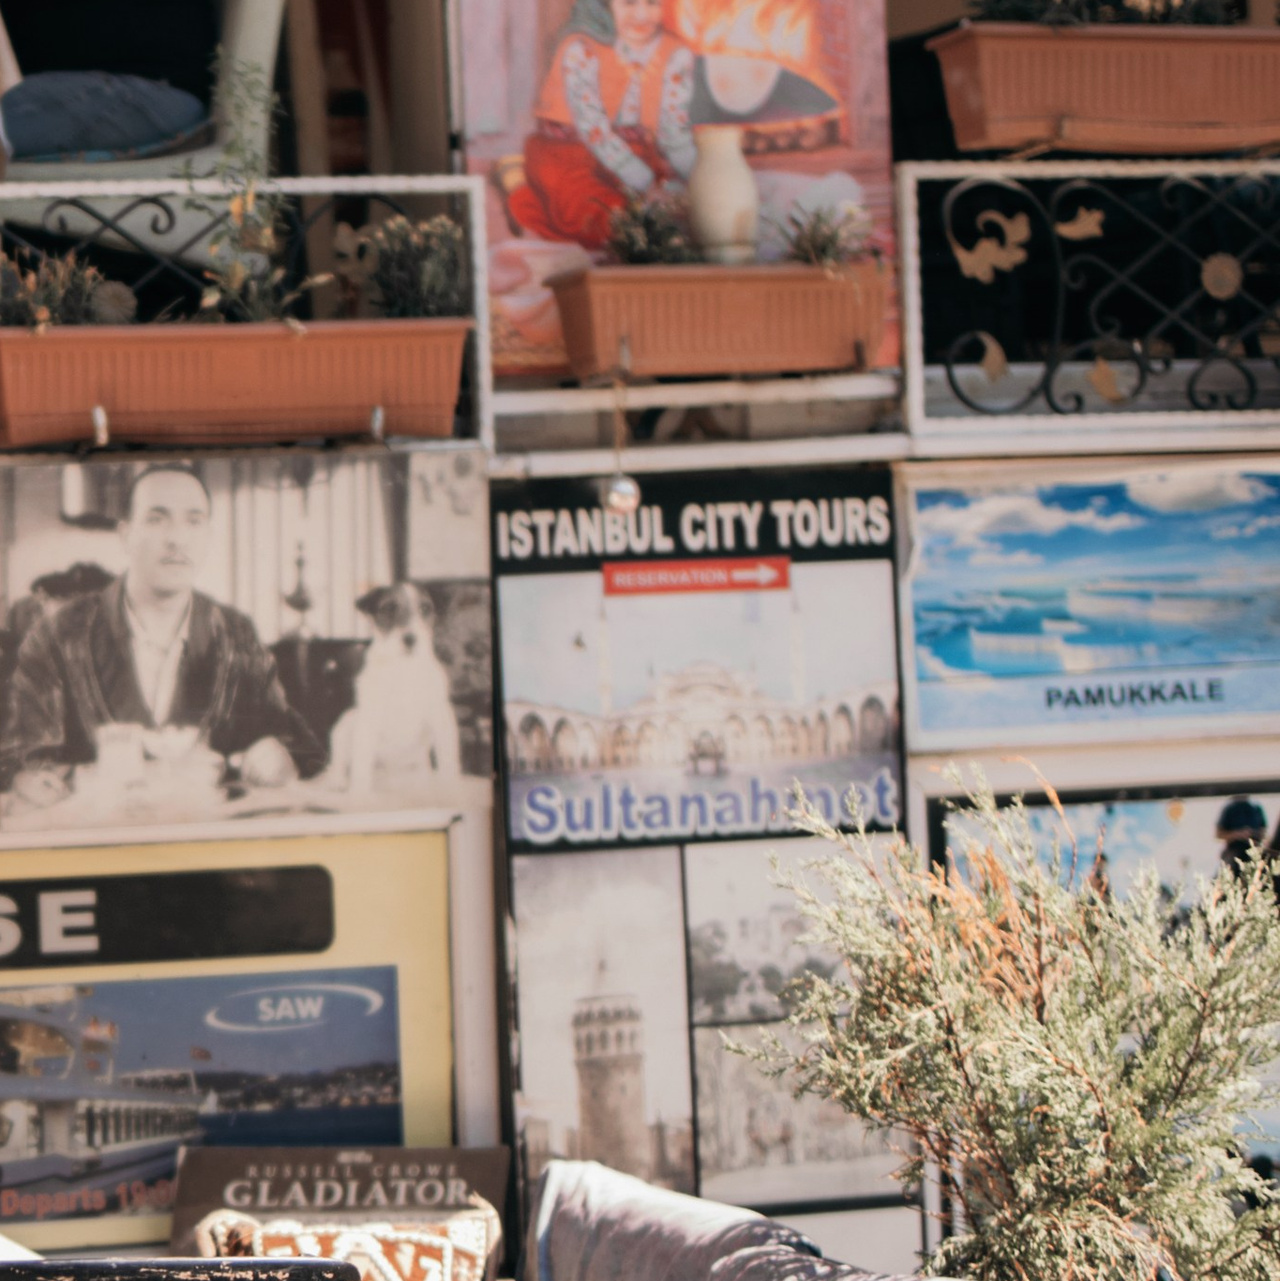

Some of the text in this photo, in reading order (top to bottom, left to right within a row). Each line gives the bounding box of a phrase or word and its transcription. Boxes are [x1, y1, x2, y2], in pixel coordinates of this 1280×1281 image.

[497, 496, 891, 560] ISTANBUL CITY TOURS
[614, 564, 728, 588] RESERVATION
[1046, 677, 1225, 708] PAMUKKALE
[257, 995, 325, 1021] SAW
[247, 1164, 458, 1178] RUSSELL CROWE
[0, 1186, 107, 1220] Departs
[223, 1178, 471, 1208] GLADIATOR
